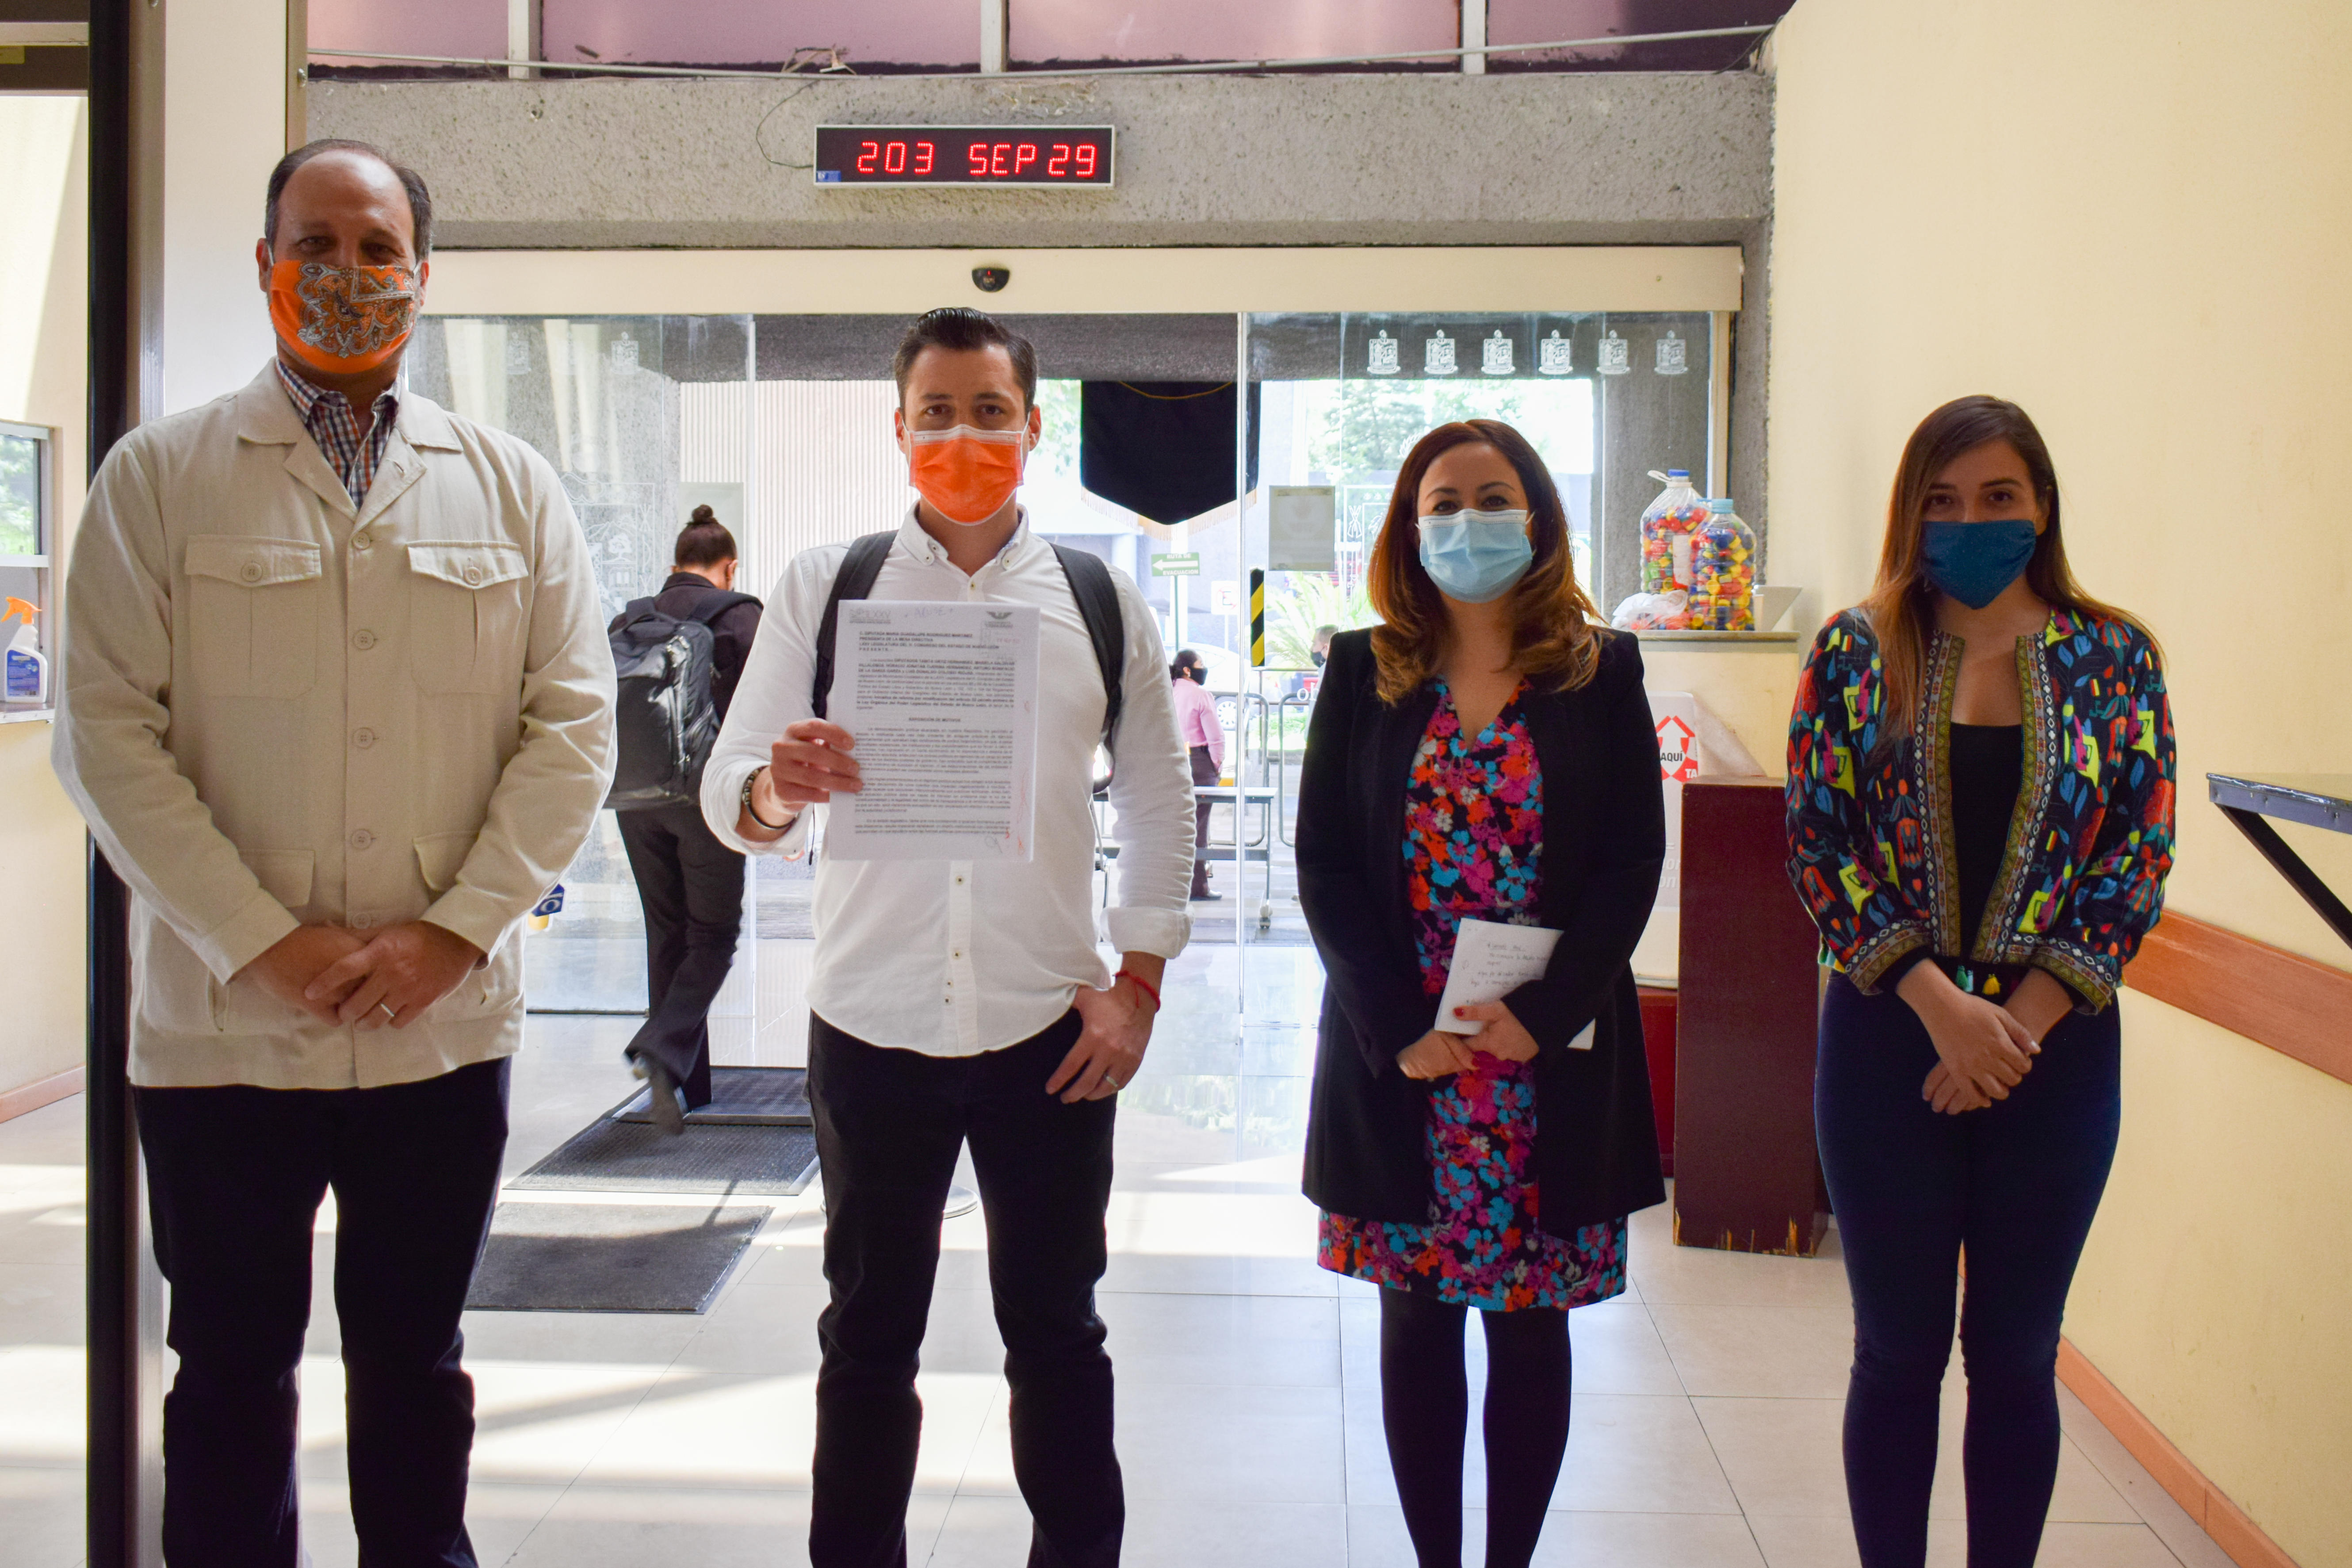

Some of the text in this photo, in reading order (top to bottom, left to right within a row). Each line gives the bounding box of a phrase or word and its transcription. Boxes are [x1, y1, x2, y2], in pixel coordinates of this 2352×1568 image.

[968, 143, 1037, 176] SEP
[1048, 144, 1097, 177] 29
[1660, 750, 1683, 762] AQUÍ
